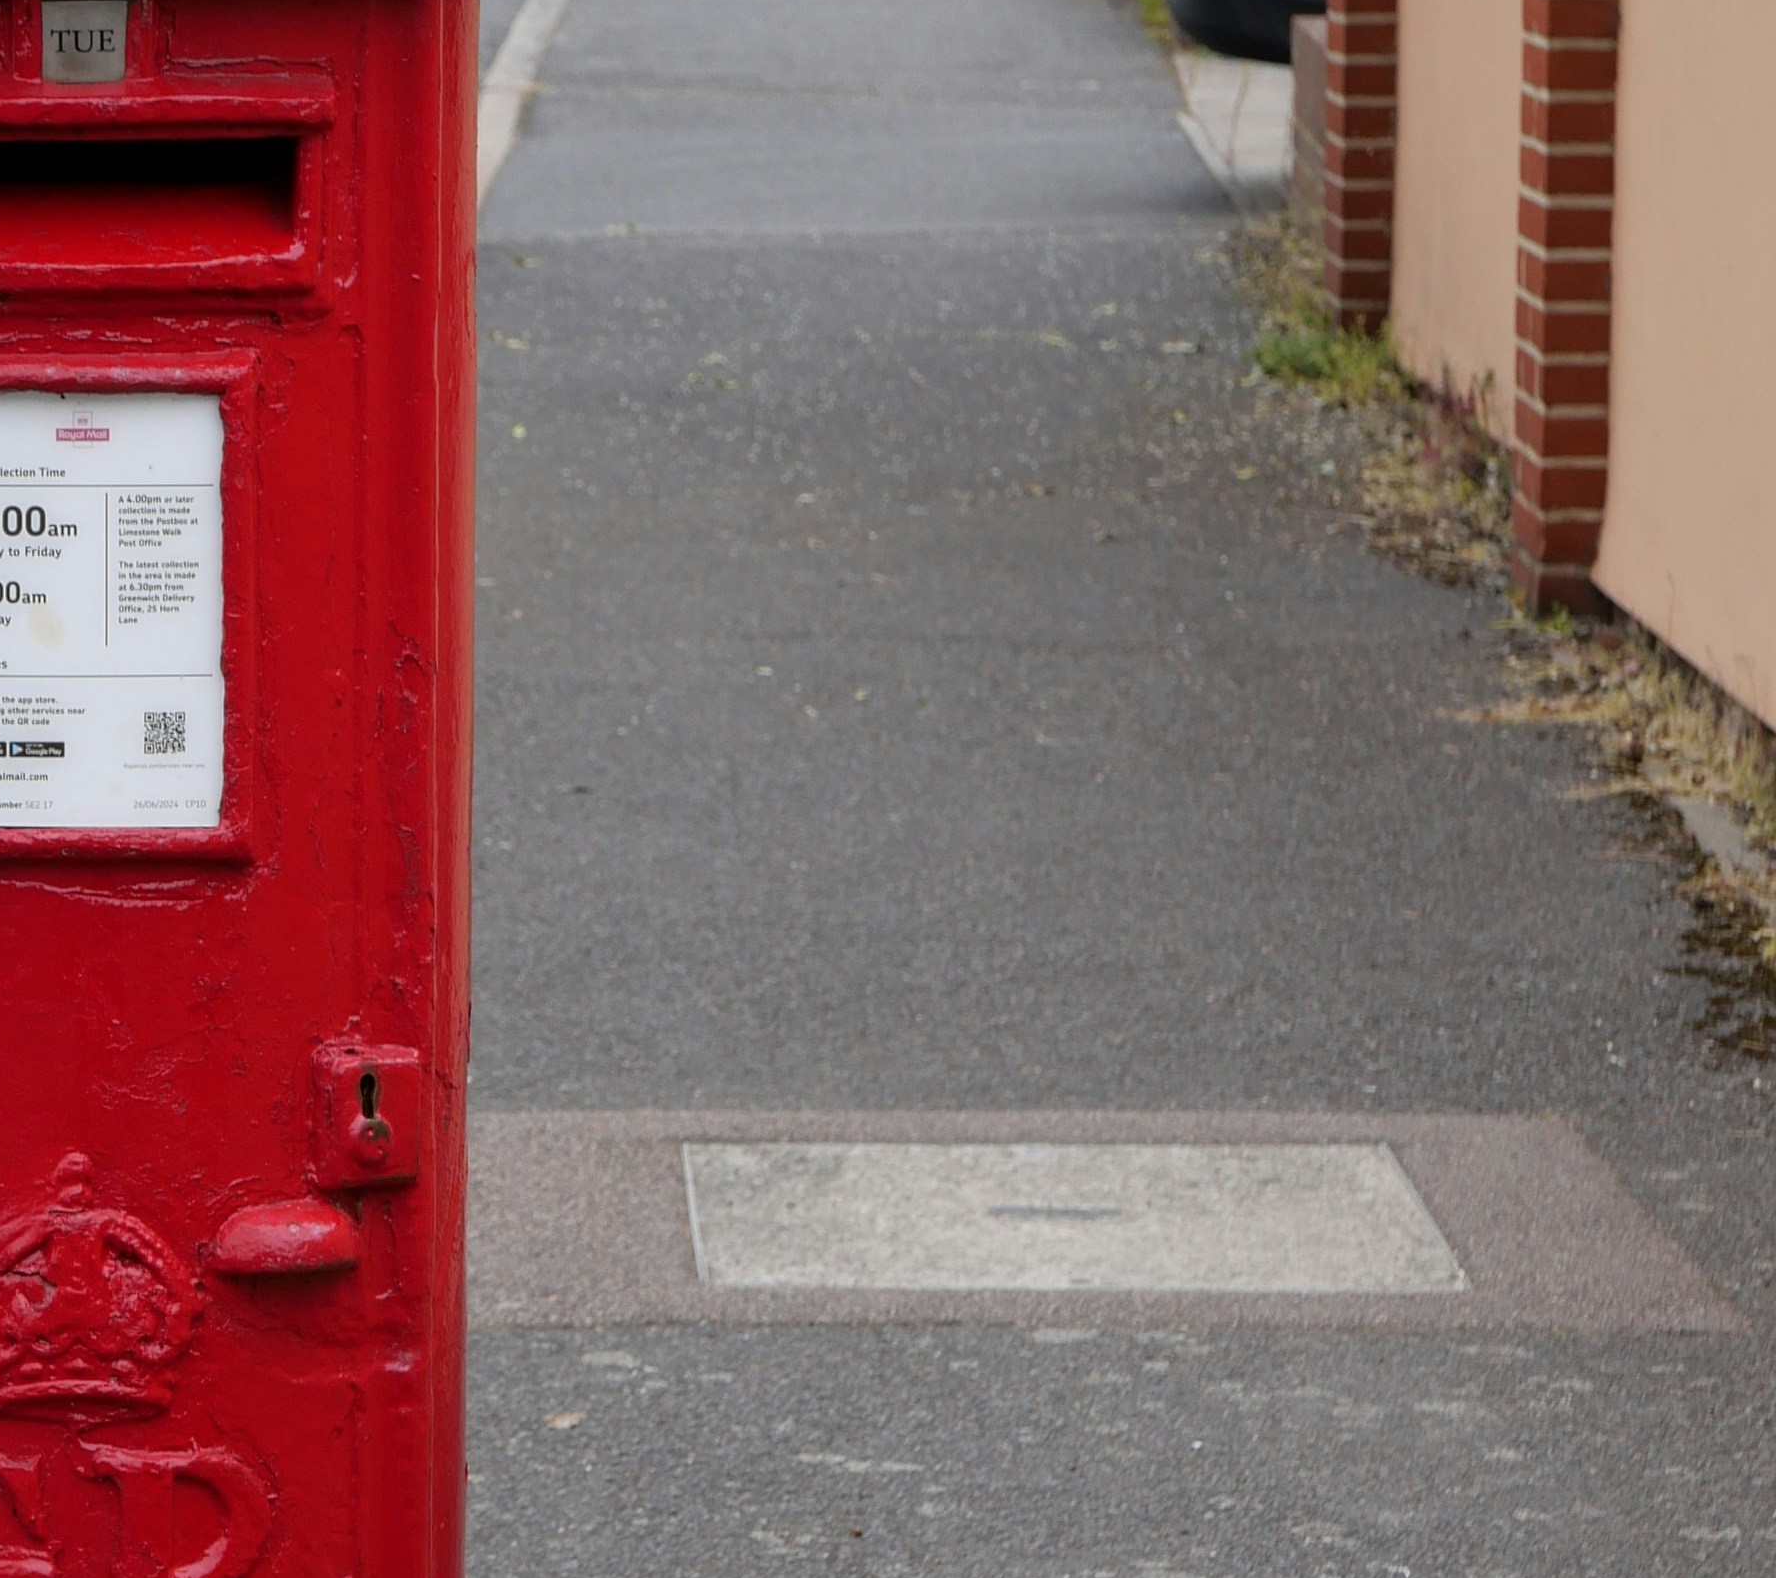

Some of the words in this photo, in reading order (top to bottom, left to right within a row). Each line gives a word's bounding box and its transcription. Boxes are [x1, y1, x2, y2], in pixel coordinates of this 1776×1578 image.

[50, 29, 115, 53] TUE
[58, 430, 84, 439] Royal
[87, 430, 107, 439] Mail
[39, 467, 66, 477] Time
[127, 495, 161, 504] 4.00pm
[9, 547, 20, 556] to
[25, 546, 62, 559] Friday
[130, 583, 162, 592] 6.30pm
[163, 594, 194, 603] Delivery
[18, 697, 32, 705] app
